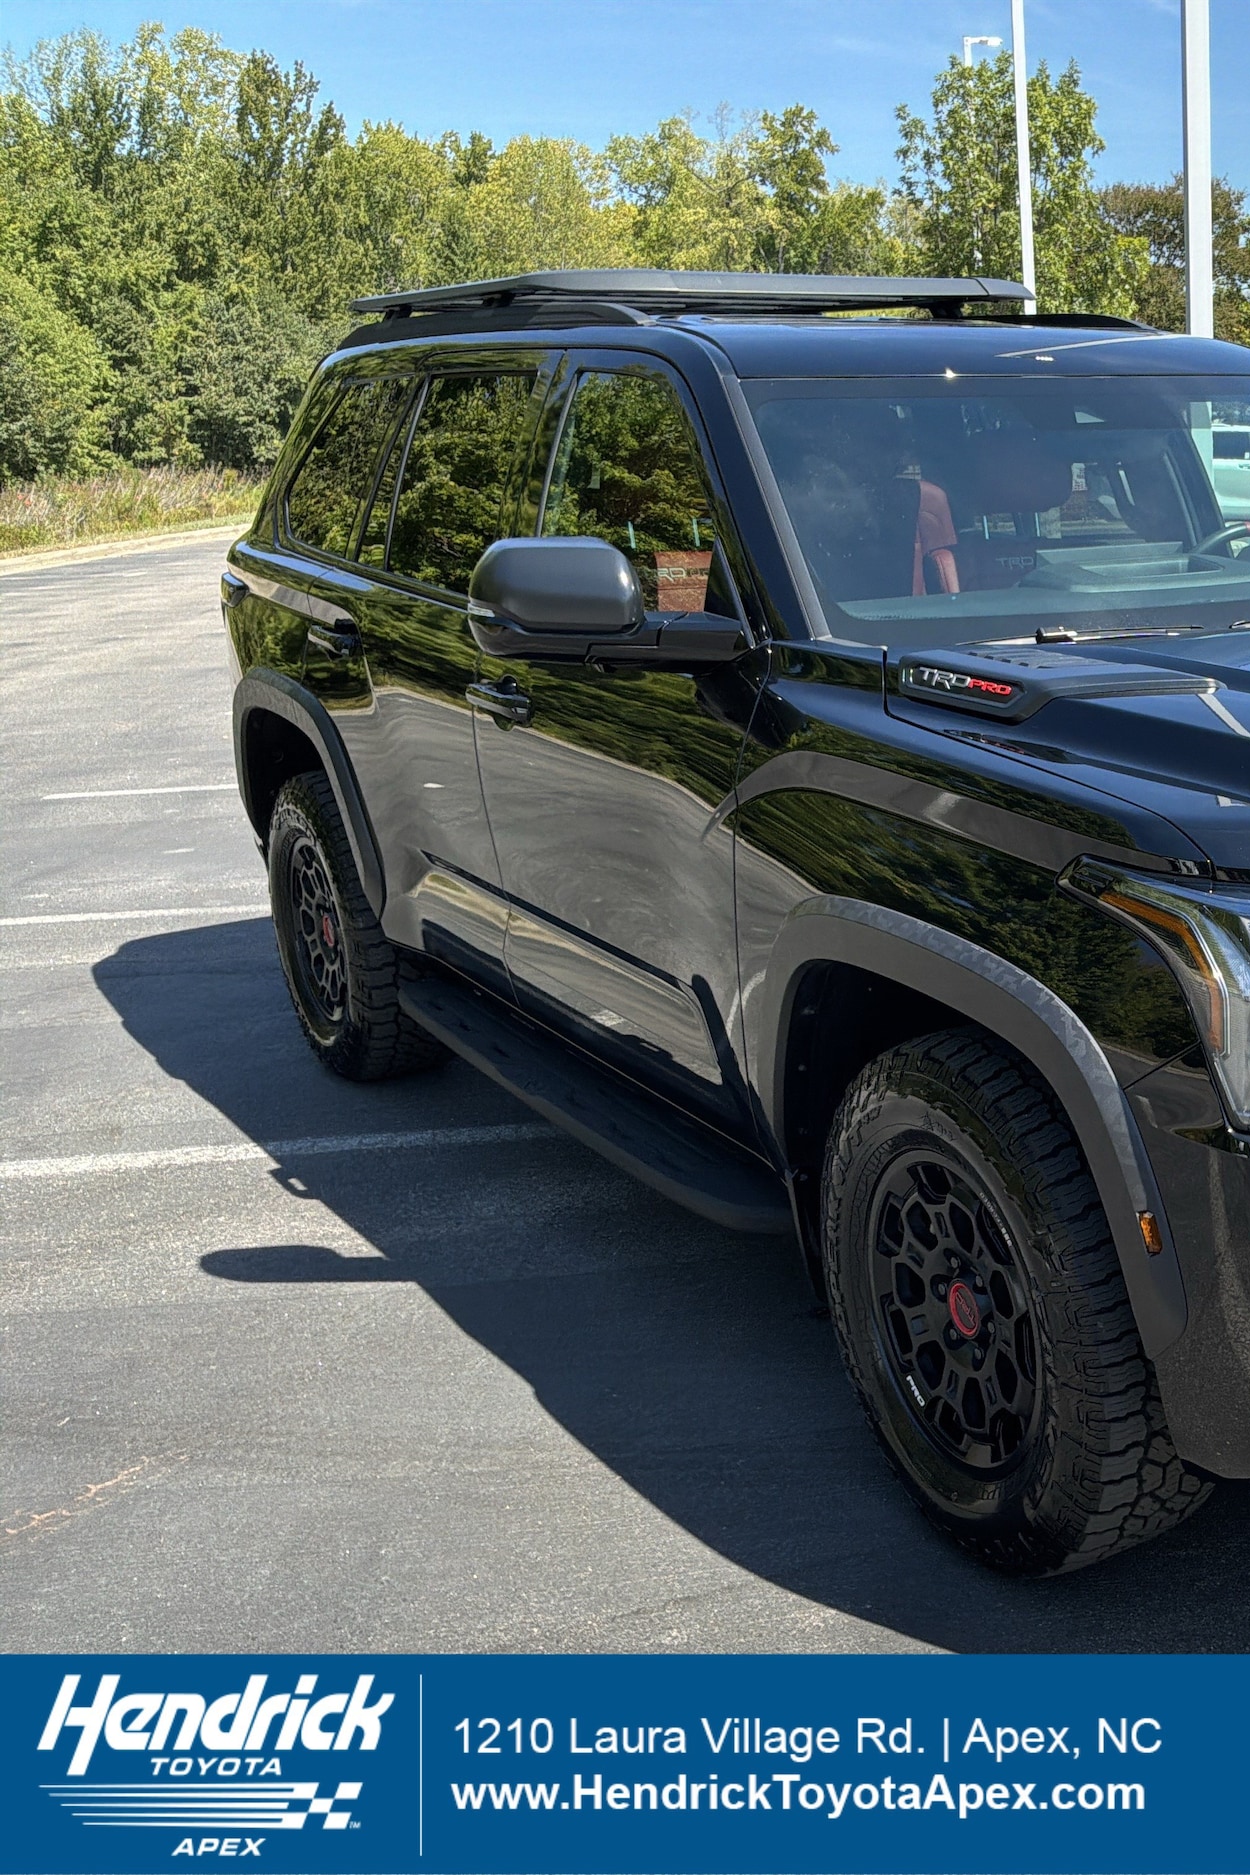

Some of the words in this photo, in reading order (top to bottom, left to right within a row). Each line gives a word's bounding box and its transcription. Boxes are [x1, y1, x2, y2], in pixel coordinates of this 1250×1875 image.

[995, 556, 1034, 570] TRD
[919, 666, 970, 690] TRD
[968, 678, 1012, 696] PRO
[906, 1375, 926, 1407] PRO
